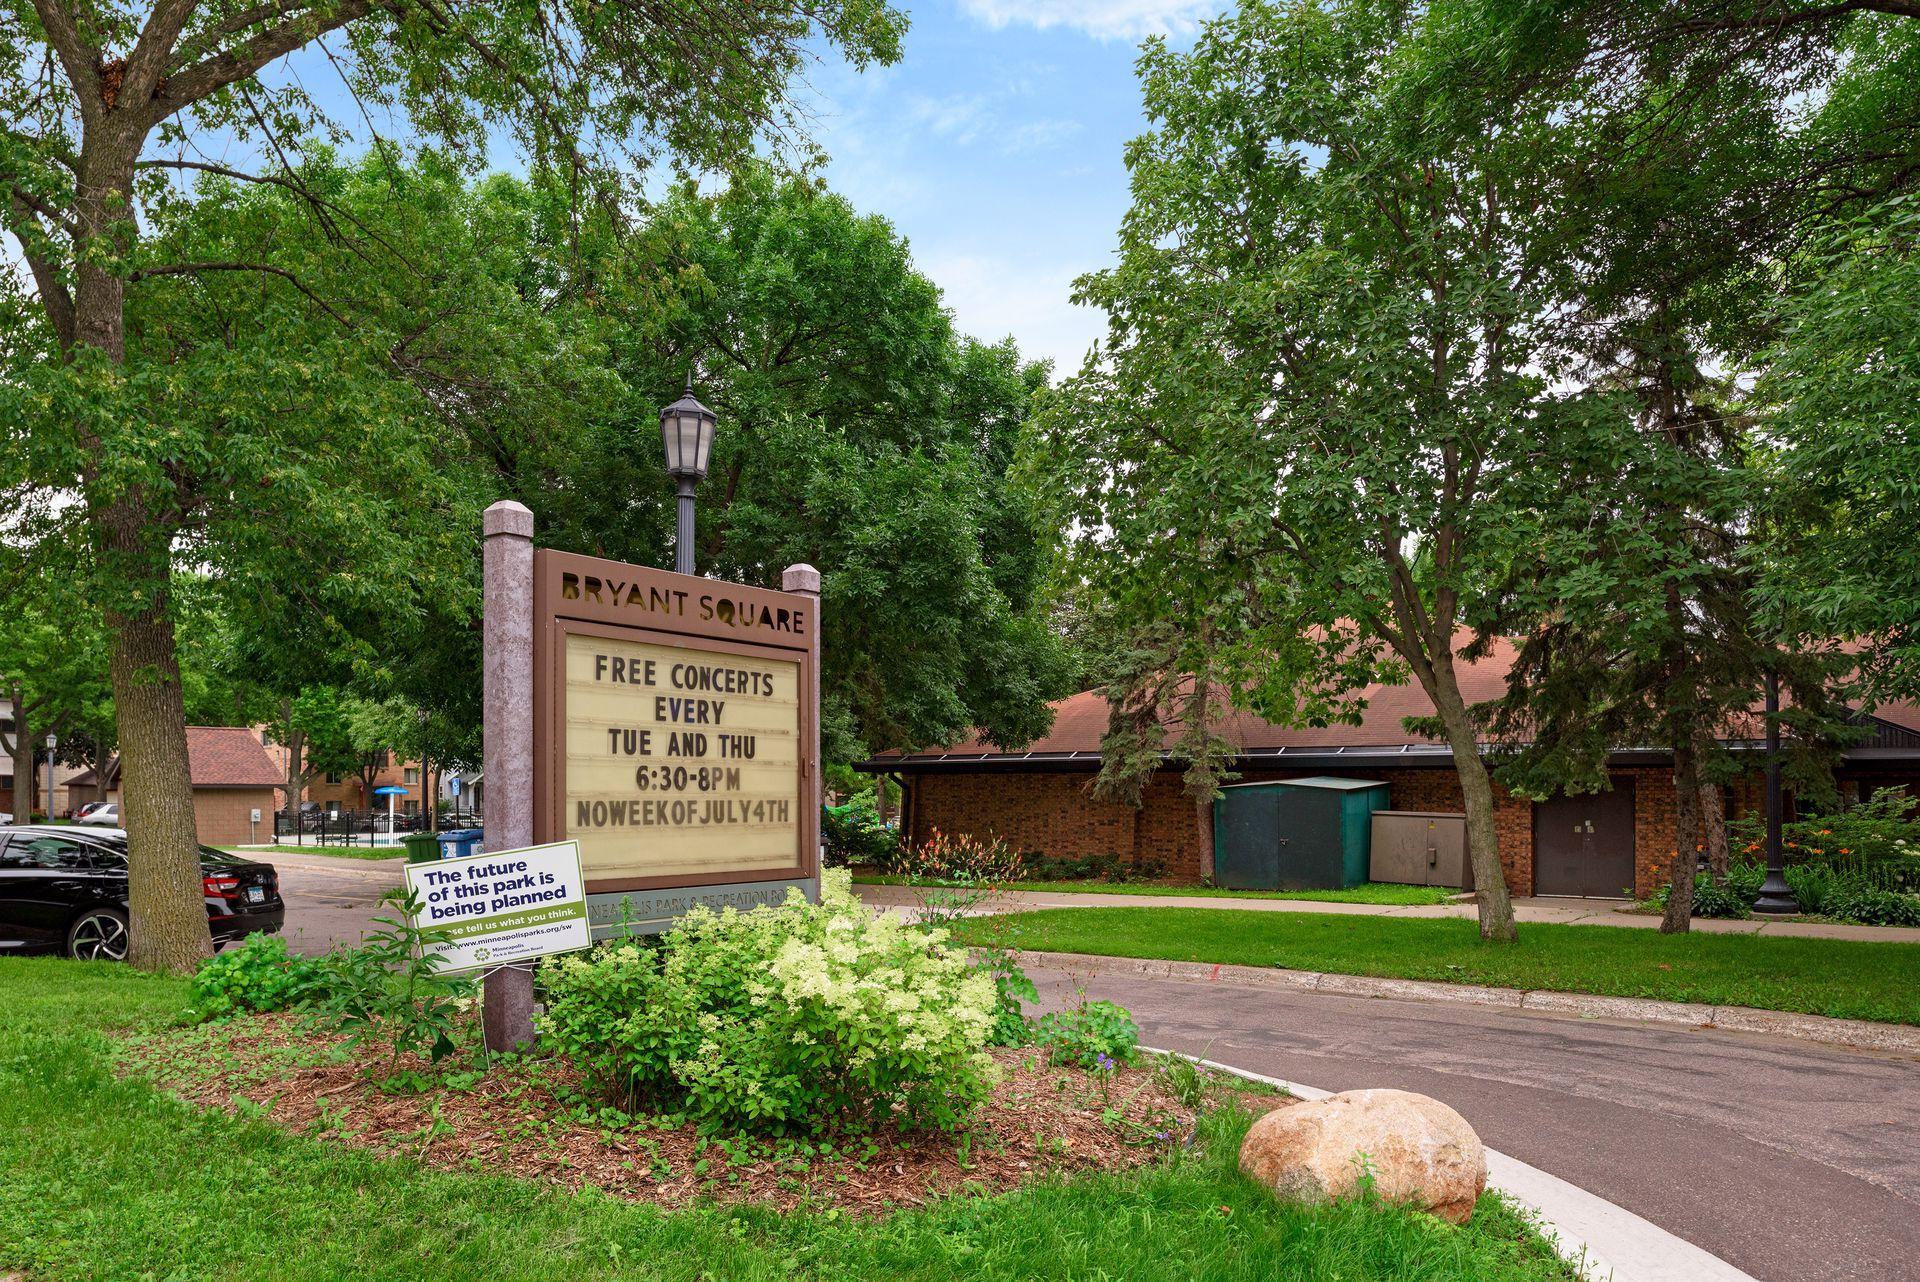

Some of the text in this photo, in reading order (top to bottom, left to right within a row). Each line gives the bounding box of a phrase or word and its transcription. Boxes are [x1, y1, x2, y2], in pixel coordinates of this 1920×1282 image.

[563, 572, 804, 634] BRYANT SQUARE
[595, 654, 774, 696] FREE CONCERTS
[654, 696, 725, 725] EVERY
[608, 728, 756, 759] TUE AND THU
[636, 765, 741, 791] 6:30-8PM
[424, 860, 528, 886] The future
[428, 872, 555, 902] of this park is
[431, 885, 567, 919] being planned
[656, 897, 687, 913] PARK
[466, 923, 483, 933] tell
[485, 922, 498, 930] us
[500, 916, 525, 927] what
[527, 914, 547, 924] you
[548, 908, 577, 919] think.
